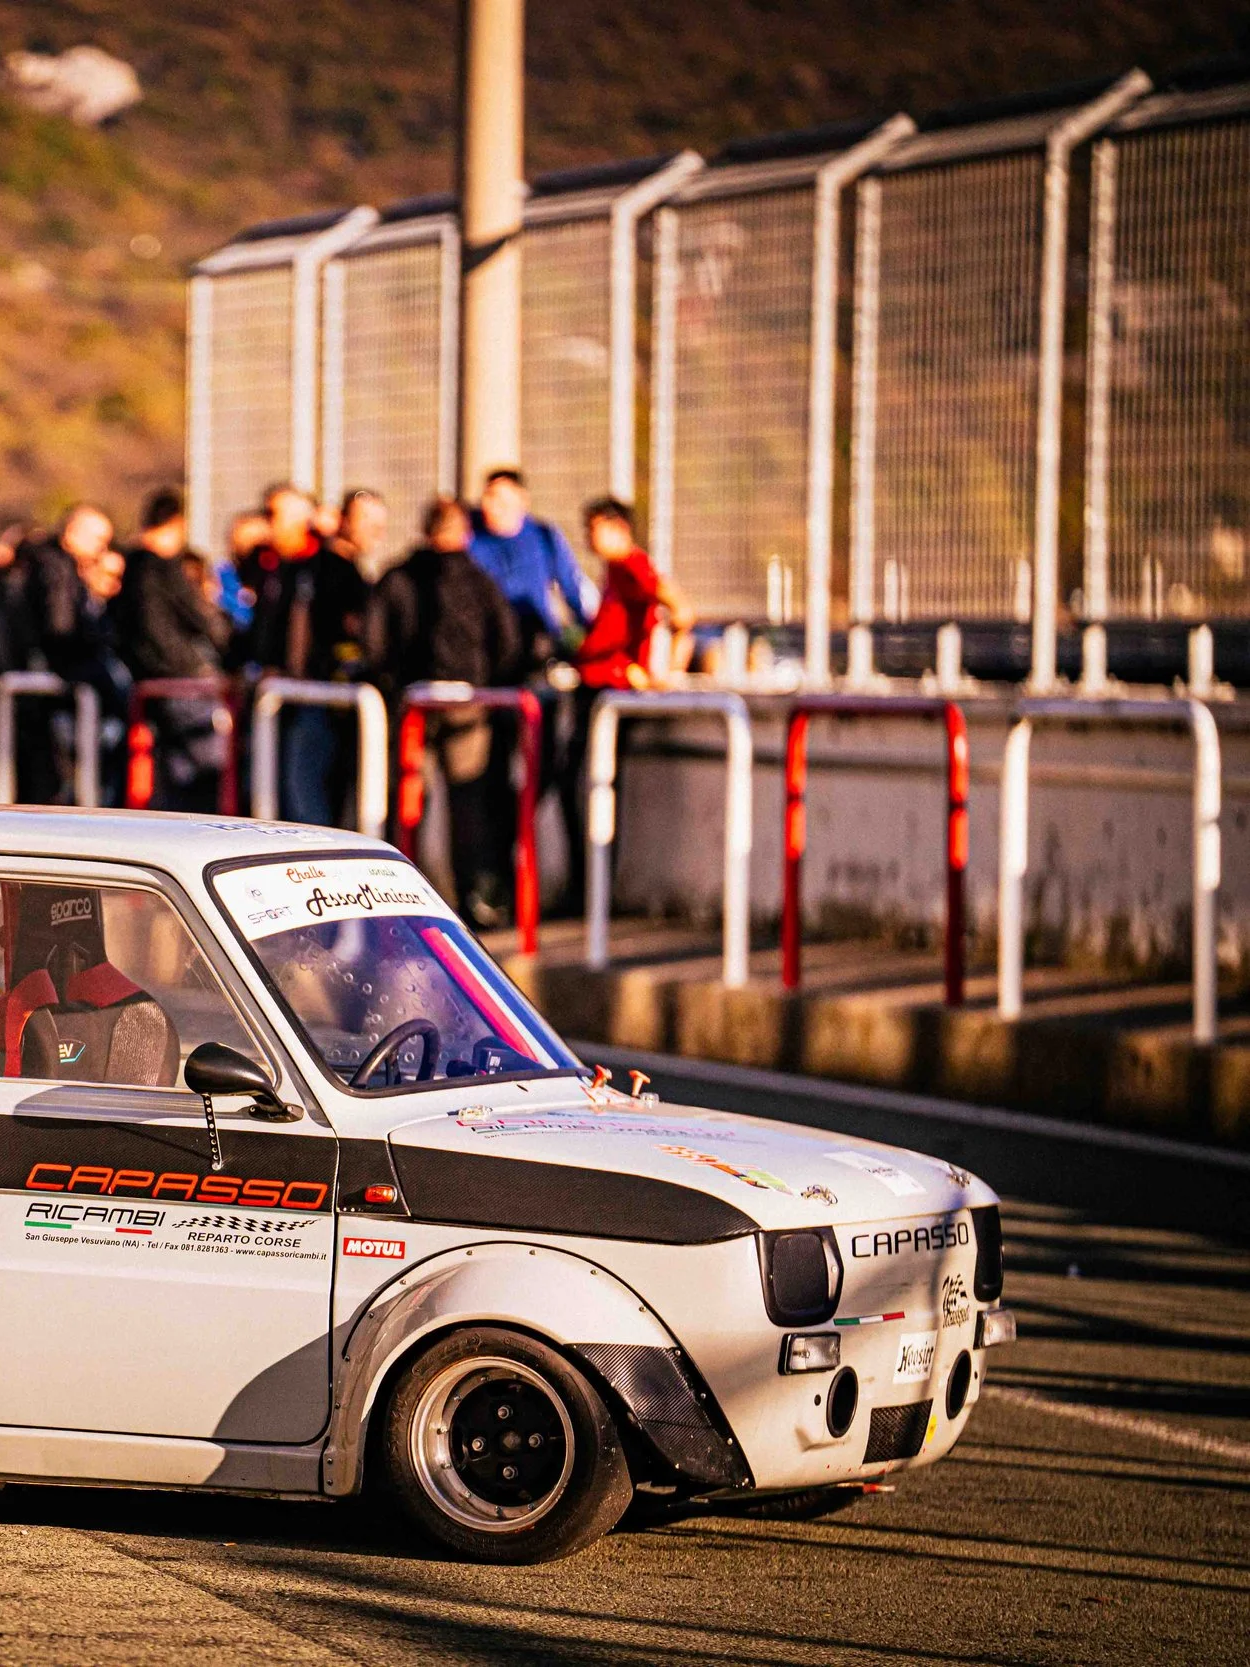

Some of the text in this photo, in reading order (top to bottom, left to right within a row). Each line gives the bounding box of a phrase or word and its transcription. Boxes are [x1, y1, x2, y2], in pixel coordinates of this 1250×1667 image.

[51, 897, 91, 920] sparco
[25, 1163, 328, 1210] CAPASSO
[25, 1203, 166, 1227] RICAMBI
[25, 1233, 40, 1241] San
[42, 1234, 79, 1244] Giuseppe
[81, 1237, 121, 1247] Vesuviano
[122, 1238, 140, 1249] (NA)
[147, 1241, 159, 1249] Tel
[164, 1243, 179, 1251] Fax
[180, 1244, 229, 1254] 081.8281363
[235, 1249, 327, 1260] www.capassoricambi.it
[187, 1231, 302, 1248] REPARTO CORSE
[345, 1239, 403, 1256] MOTUL
[851, 1222, 969, 1258] CAPASSO
